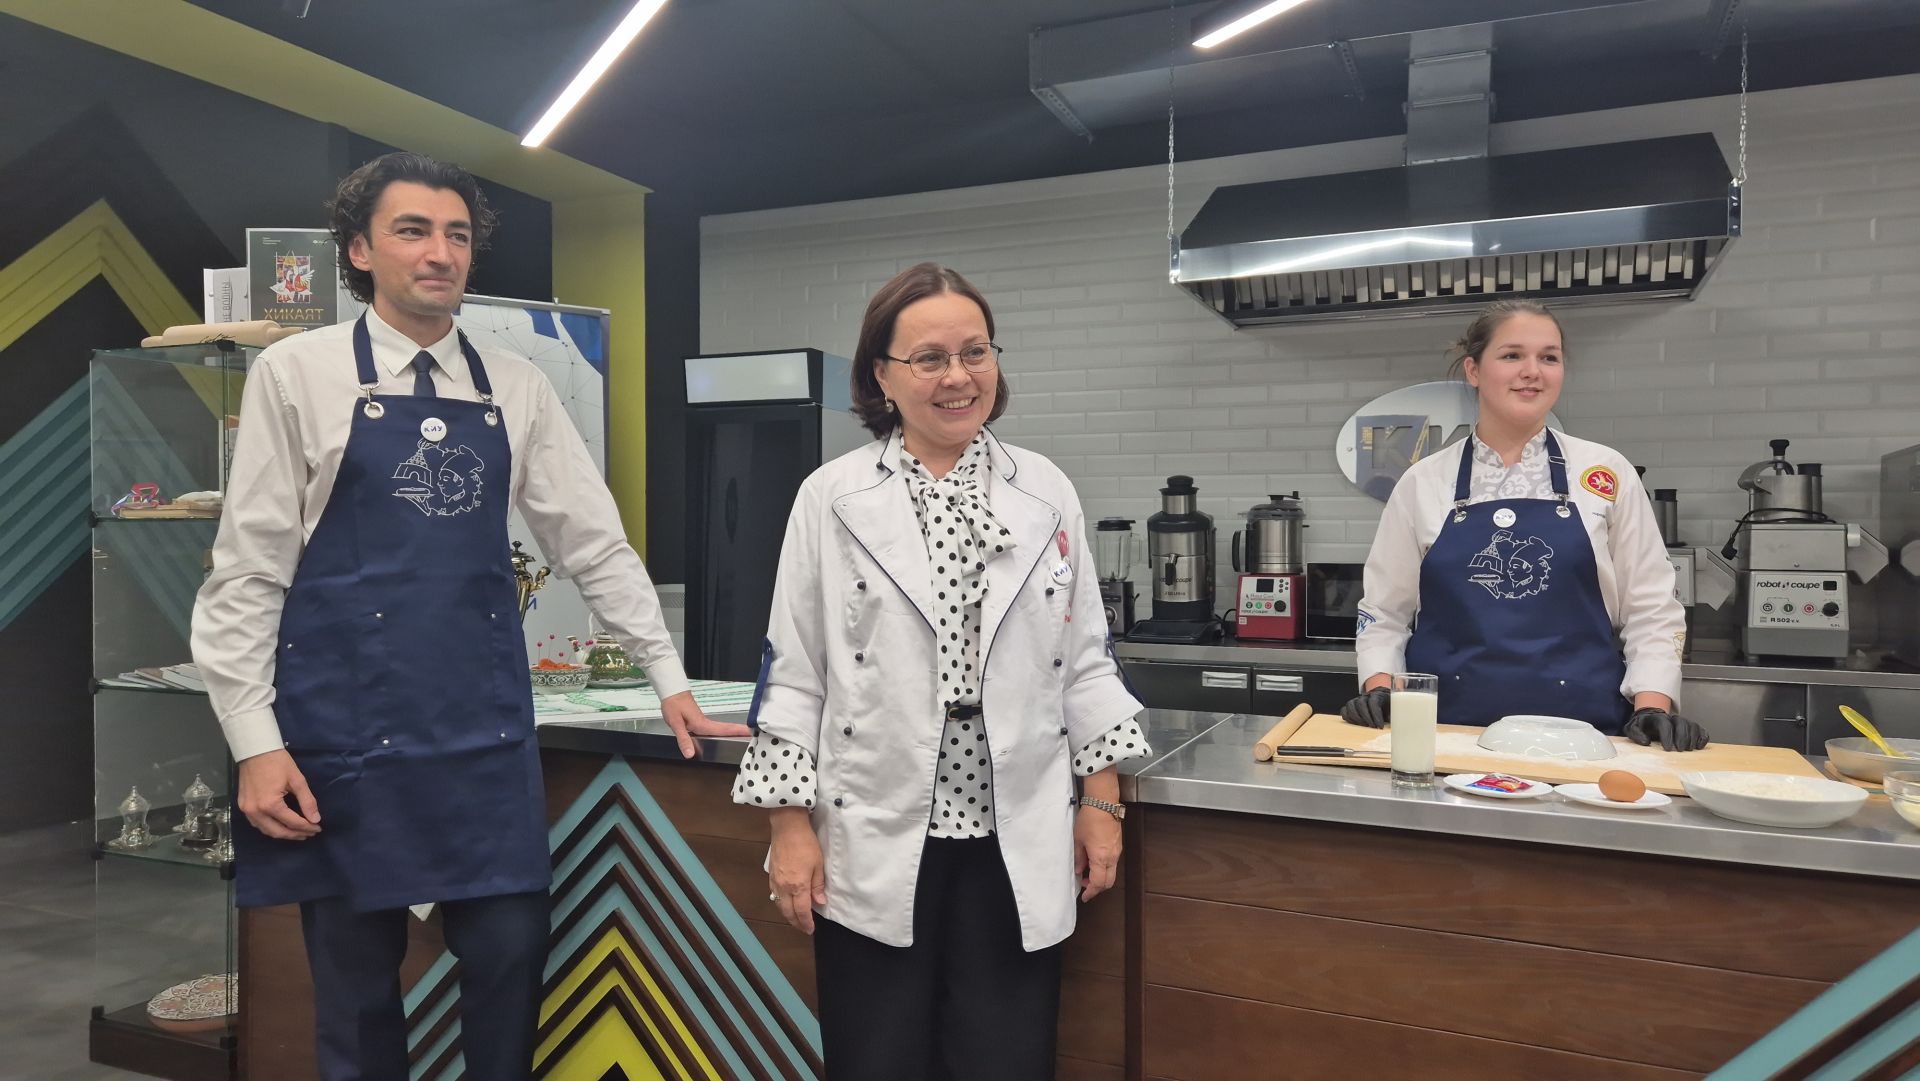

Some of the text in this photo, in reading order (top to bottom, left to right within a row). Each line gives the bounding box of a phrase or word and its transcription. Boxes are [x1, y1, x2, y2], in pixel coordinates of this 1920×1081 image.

[264, 308, 324, 320] ХИКАЯТ
[1053, 565, 1068, 578] КИУ
[1791, 582, 1820, 590] coupe
